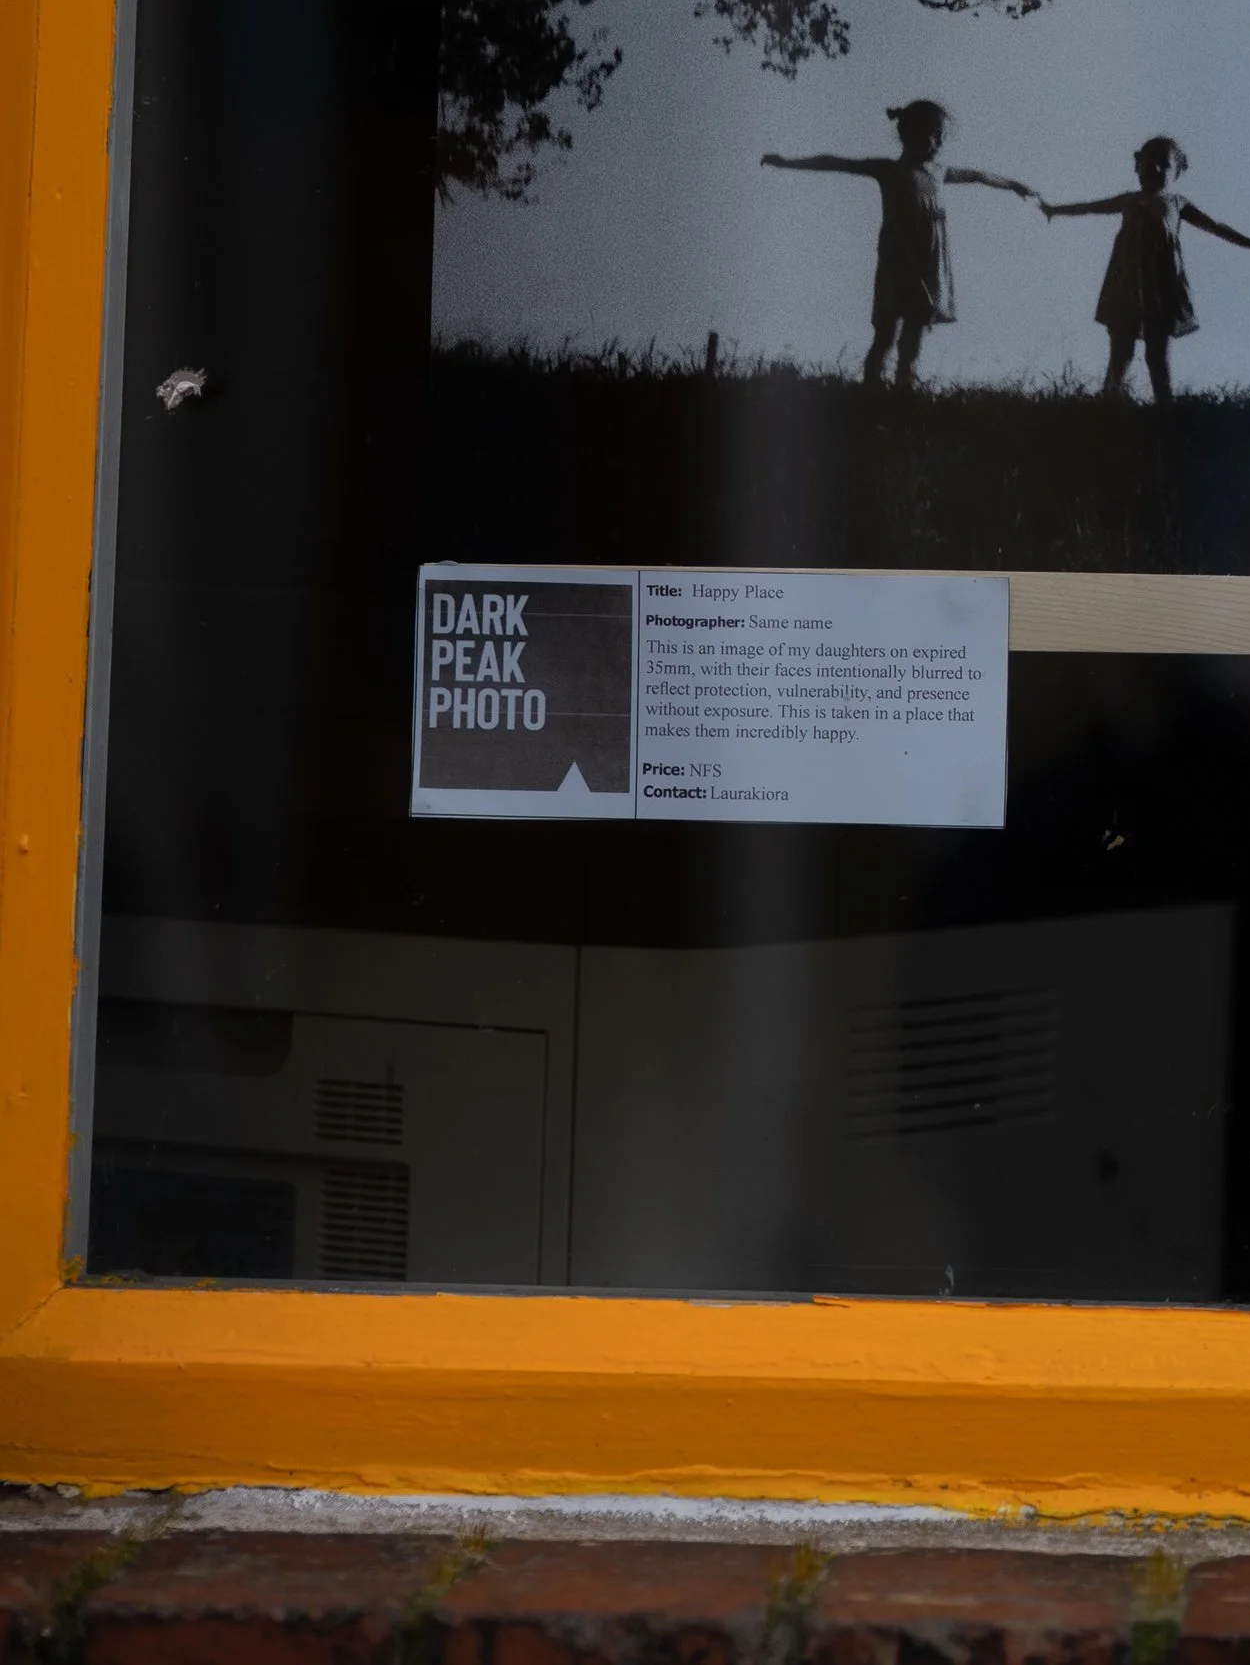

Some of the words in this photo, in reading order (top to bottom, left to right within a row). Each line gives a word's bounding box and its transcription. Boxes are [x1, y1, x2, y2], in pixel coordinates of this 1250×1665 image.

[647, 584, 682, 598] Title:
[692, 583, 740, 602] Happy
[745, 584, 784, 599] Place
[432, 593, 529, 638] DARK
[645, 613, 745, 631] Photographer:
[748, 614, 790, 629] Same
[793, 619, 833, 630] name
[432, 640, 527, 683] PEAK
[646, 639, 678, 655] This
[682, 640, 694, 655] is
[698, 644, 716, 655] an
[720, 641, 765, 660] image
[768, 641, 786, 657] of
[788, 646, 811, 660] my
[815, 642, 886, 661] daughters
[889, 647, 909, 659] on
[912, 644, 966, 663] expired
[646, 659, 696, 678] 35mm,
[700, 661, 732, 676] with
[736, 662, 770, 677] their
[774, 662, 812, 678] faces
[816, 663, 907, 683] intentionally
[911, 664, 963, 680] blurred
[967, 668, 982, 681] to
[645, 680, 691, 696] reflect
[694, 682, 772, 700] protection,
[777, 683, 872, 703] vulnerability,
[876, 685, 902, 700] and
[907, 689, 970, 704] presence
[429, 687, 546, 732] PHOTO
[645, 701, 700, 717] without
[703, 706, 773, 721] exposure.
[777, 703, 810, 719] This
[815, 704, 827, 719] is
[831, 705, 870, 720] taken
[874, 705, 888, 720] in
[892, 710, 902, 720] a
[905, 706, 944, 725] place
[947, 707, 975, 722] that
[644, 722, 691, 738] makes
[694, 723, 730, 738] them
[735, 724, 808, 743] incredibly
[812, 725, 859, 744] happy.
[642, 762, 685, 777] Price:
[689, 763, 722, 778] NFS
[643, 784, 707, 800] Contact:
[710, 785, 789, 801] Laurakiora
